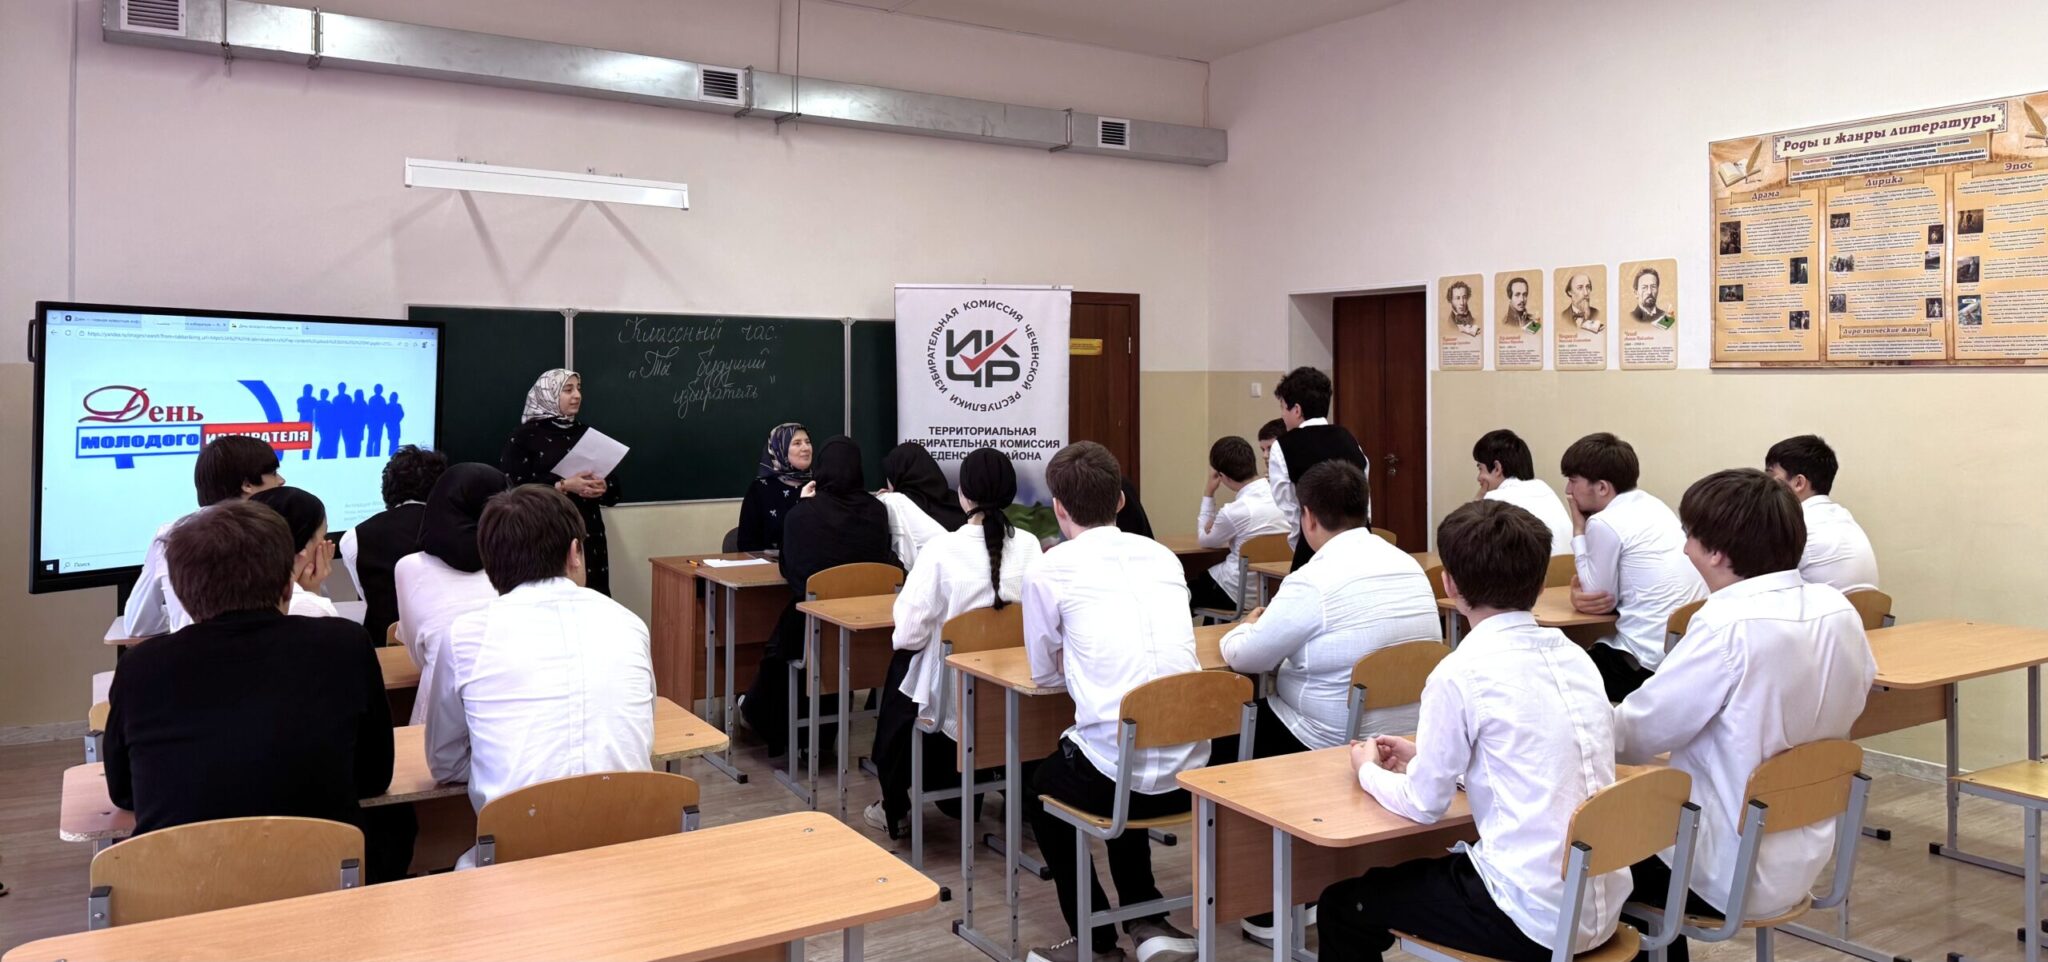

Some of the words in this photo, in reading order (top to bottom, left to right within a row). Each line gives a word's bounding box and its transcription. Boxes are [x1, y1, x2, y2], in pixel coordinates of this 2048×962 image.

[1783, 138, 1819, 152] Роды
[1822, 136, 1831, 146] и
[1834, 129, 1887, 145] жанры
[1889, 113, 1997, 137] литературы
[2004, 162, 2033, 171] Эпос
[1865, 176, 1904, 187] Лирика
[1751, 191, 1780, 201] Драма
[963, 299, 1024, 323] КОМИССИЯ
[618, 316, 724, 343] Классный
[927, 307, 960, 394] ИЗБИРАТЕЛЬНАЯ
[1021, 323, 1040, 391] ЧЕЧЕНСКОЙ
[696, 345, 770, 388] будущий
[946, 359, 1020, 388] ЧР
[78, 385, 204, 423] День
[949, 391, 1022, 412] РЕСПУБЛИКИ
[80, 434, 199, 450] МОЛОДОГО
[928, 426, 1037, 436] ТЕРРИТОРИАЛЬНАЯ
[1000, 439, 1061, 449] КОМИССИЯ
[1006, 450, 1042, 461] АЙОНА
